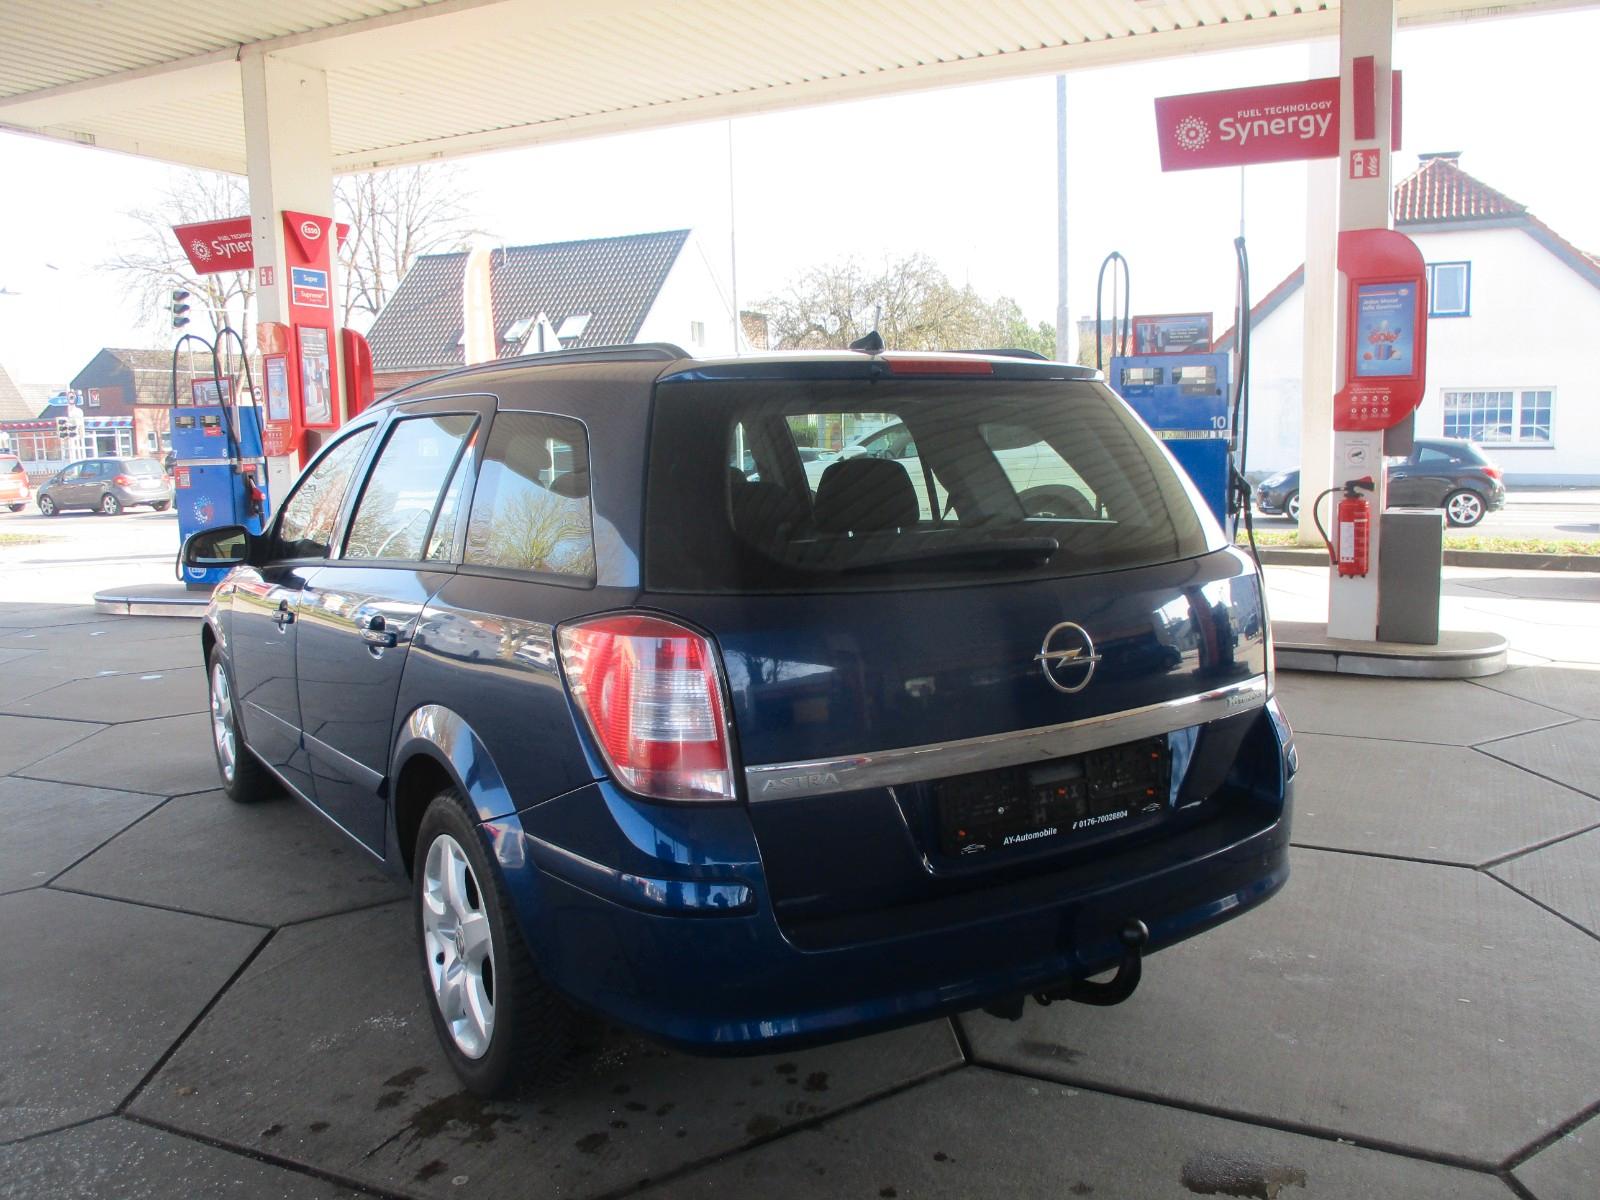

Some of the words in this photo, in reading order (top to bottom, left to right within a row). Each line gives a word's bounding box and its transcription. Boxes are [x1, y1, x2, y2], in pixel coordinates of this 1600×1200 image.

[1237, 108, 1262, 119] FUEL
[1264, 101, 1333, 116] TECHNOLOGY
[1218, 113, 1333, 145] Synergy
[211, 240, 253, 259] Syner
[1210, 416, 1226, 429] 10
[222, 448, 227, 457] 8
[762, 772, 840, 792] ASTRA
[1003, 827, 1058, 846] AY-Automobile
